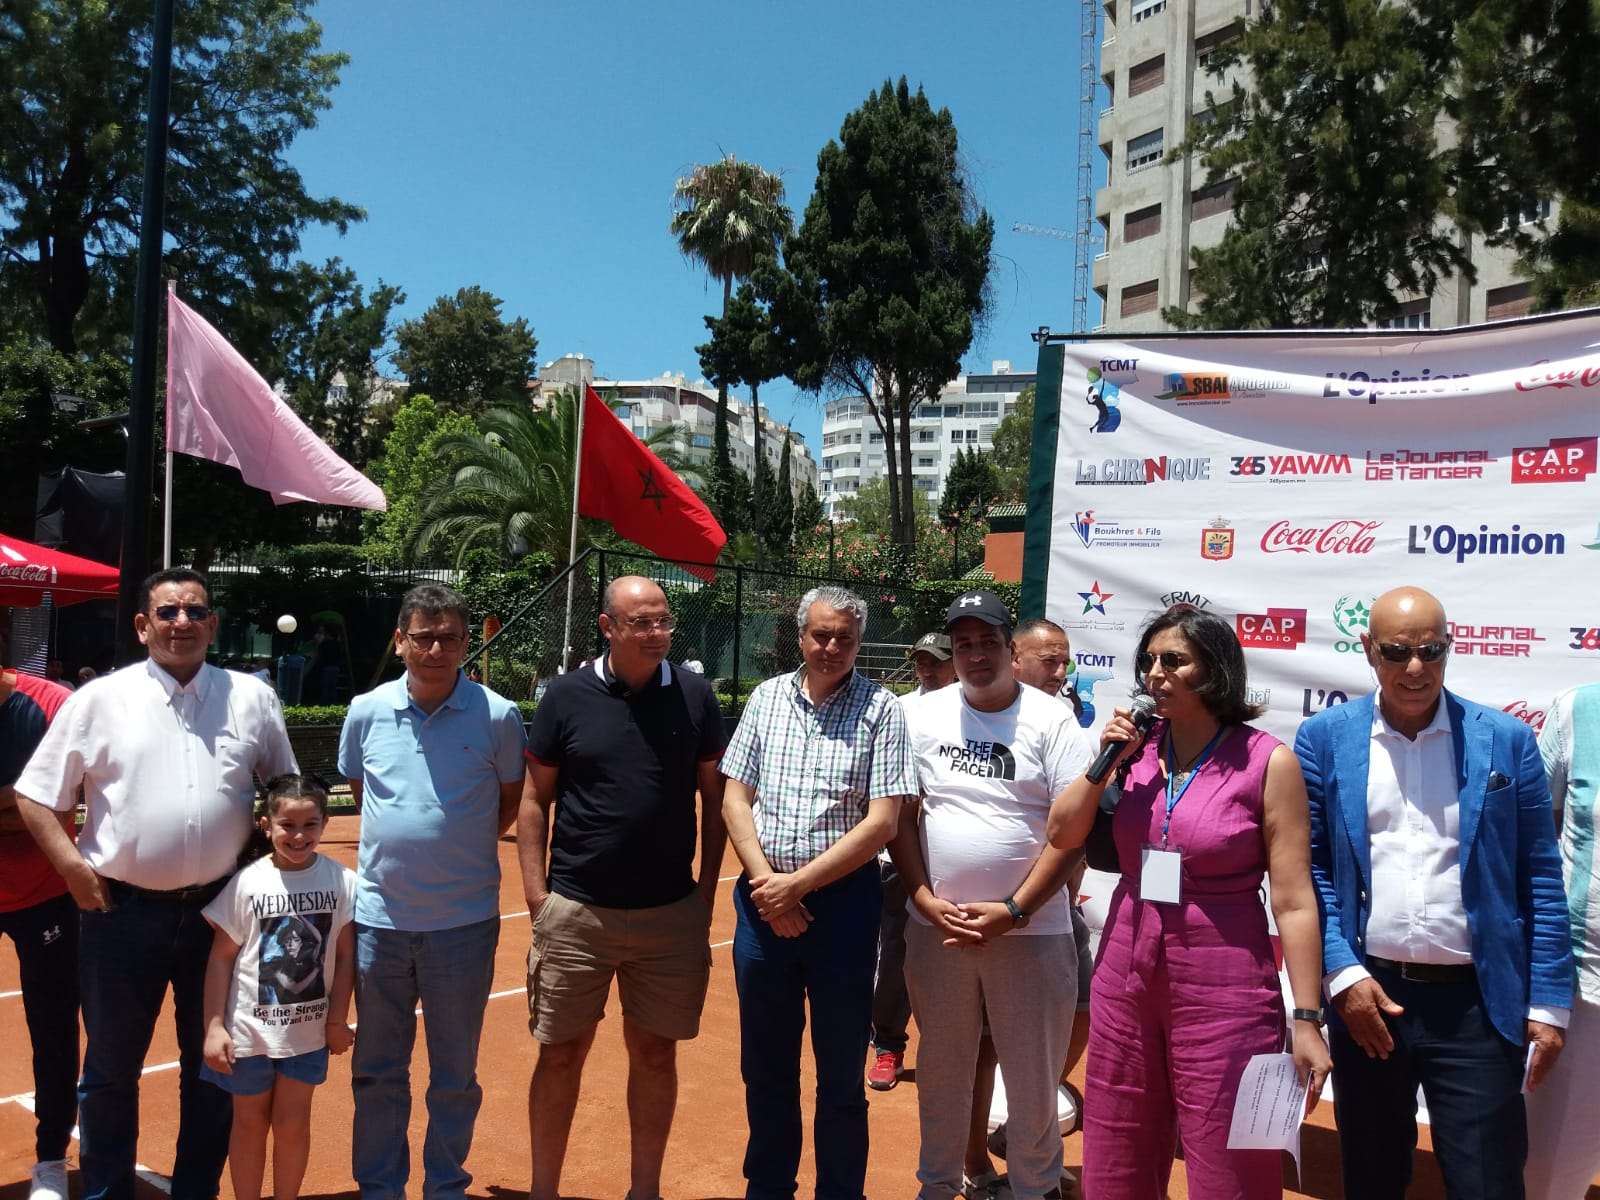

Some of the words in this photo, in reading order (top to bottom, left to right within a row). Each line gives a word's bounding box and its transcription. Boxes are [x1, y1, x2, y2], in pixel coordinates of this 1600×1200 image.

[1100, 358, 1140, 372] TCMT
[1192, 376, 1228, 395] SBAI
[1229, 456, 1265, 476] 365
[1268, 454, 1352, 475] YAWM
[1518, 448, 1584, 467] CAP
[1076, 459, 1097, 481] La
[1101, 455, 1211, 483] CHRONIQUE
[1521, 467, 1579, 476] RADIO
[1094, 527, 1135, 536] Boukhres
[1137, 527, 1143, 536] &
[1145, 527, 1161, 536] Fils
[1260, 519, 1384, 555] Coca-Cola
[1408, 524, 1565, 564] L'Opinion
[1160, 591, 1213, 609] FRMT
[1241, 616, 1296, 634] CAP
[1244, 634, 1291, 642] RADIO
[1334, 640, 1365, 653] OC
[1076, 653, 1116, 667] TCMT
[1246, 687, 1271, 704] hai
[1302, 688, 1349, 717] L'O
[966, 738, 992, 753] THE
[939, 745, 990, 765] NORTH
[950, 760, 987, 777] FACE
[250, 890, 338, 919] WEDNESDAY
[253, 1008, 269, 1018] Be
[272, 1007, 291, 1017] the
[262, 1018, 277, 1026] You
[280, 1016, 302, 1026] Want
[304, 1014, 313, 1022] to
